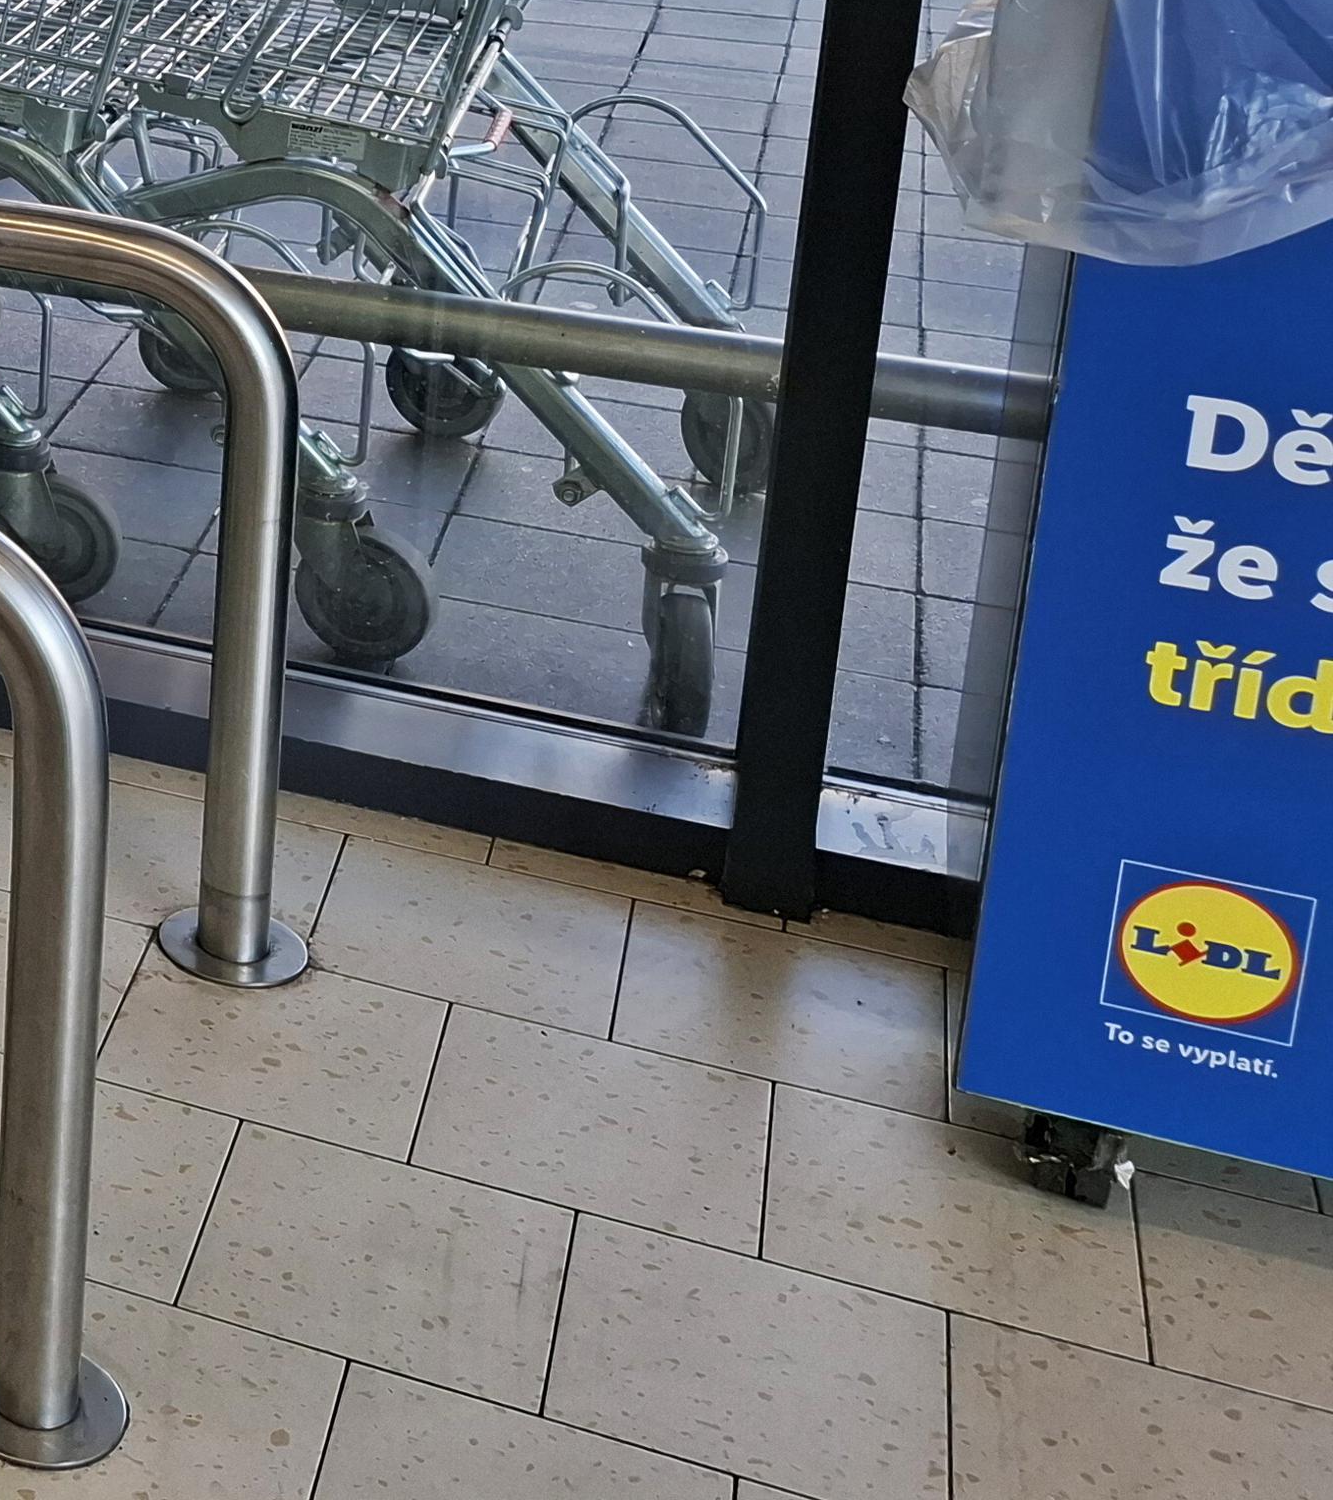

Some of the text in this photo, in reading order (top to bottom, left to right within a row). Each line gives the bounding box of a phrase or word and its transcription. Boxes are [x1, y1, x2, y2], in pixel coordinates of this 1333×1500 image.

[1185, 394, 1333, 487] Dě
[1159, 515, 1279, 601] že
[1145, 640, 1333, 735] tříd
[1104, 1022, 1279, 1079] To se vyplatí.
